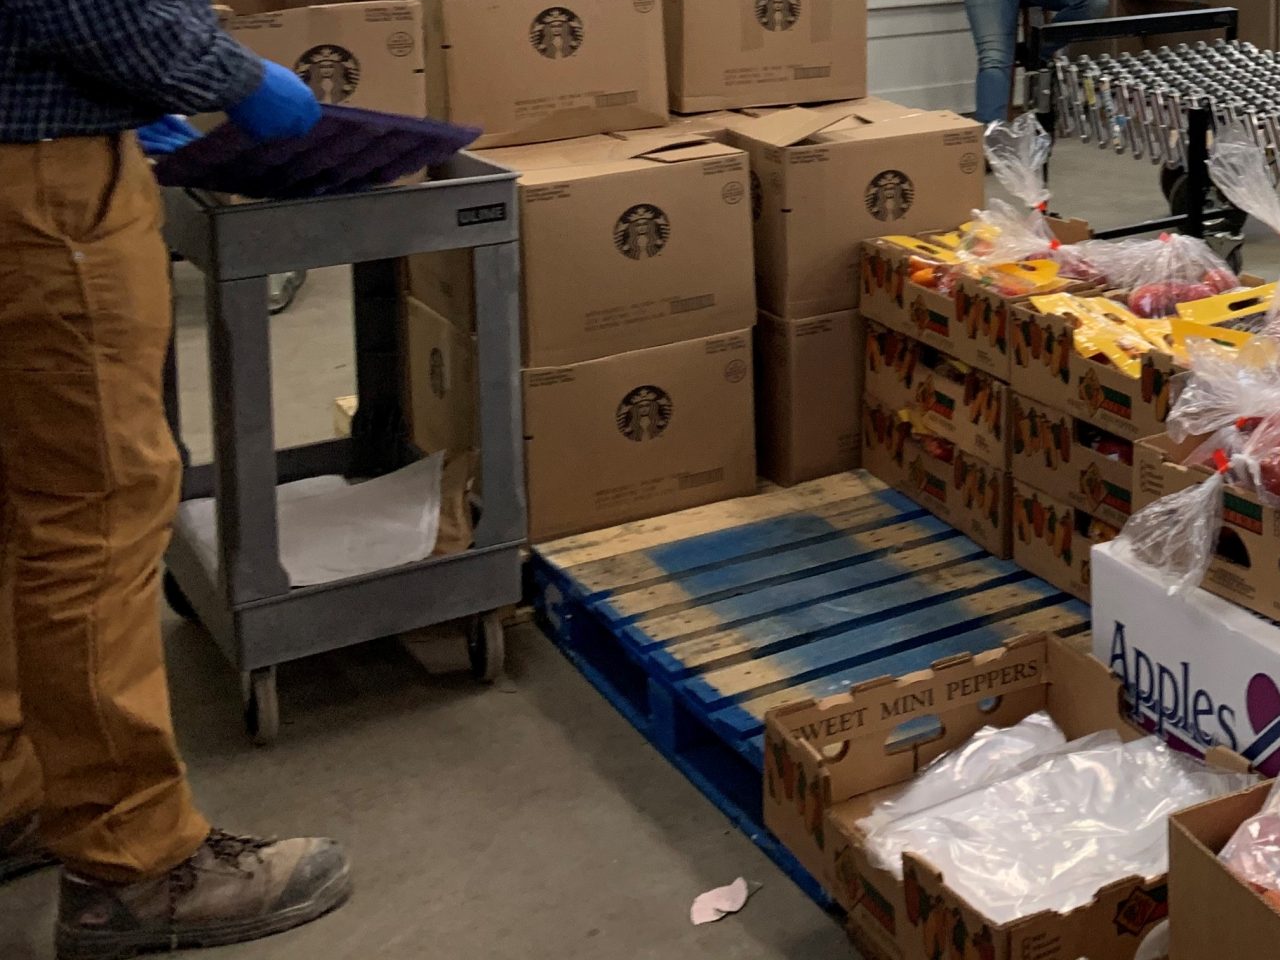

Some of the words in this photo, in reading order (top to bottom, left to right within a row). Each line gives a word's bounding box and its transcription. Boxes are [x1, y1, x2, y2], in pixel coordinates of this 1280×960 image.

[879, 687, 934, 721] MINI
[946, 659, 1038, 702] PEPPERS
[1110, 620, 1238, 751] Apples
